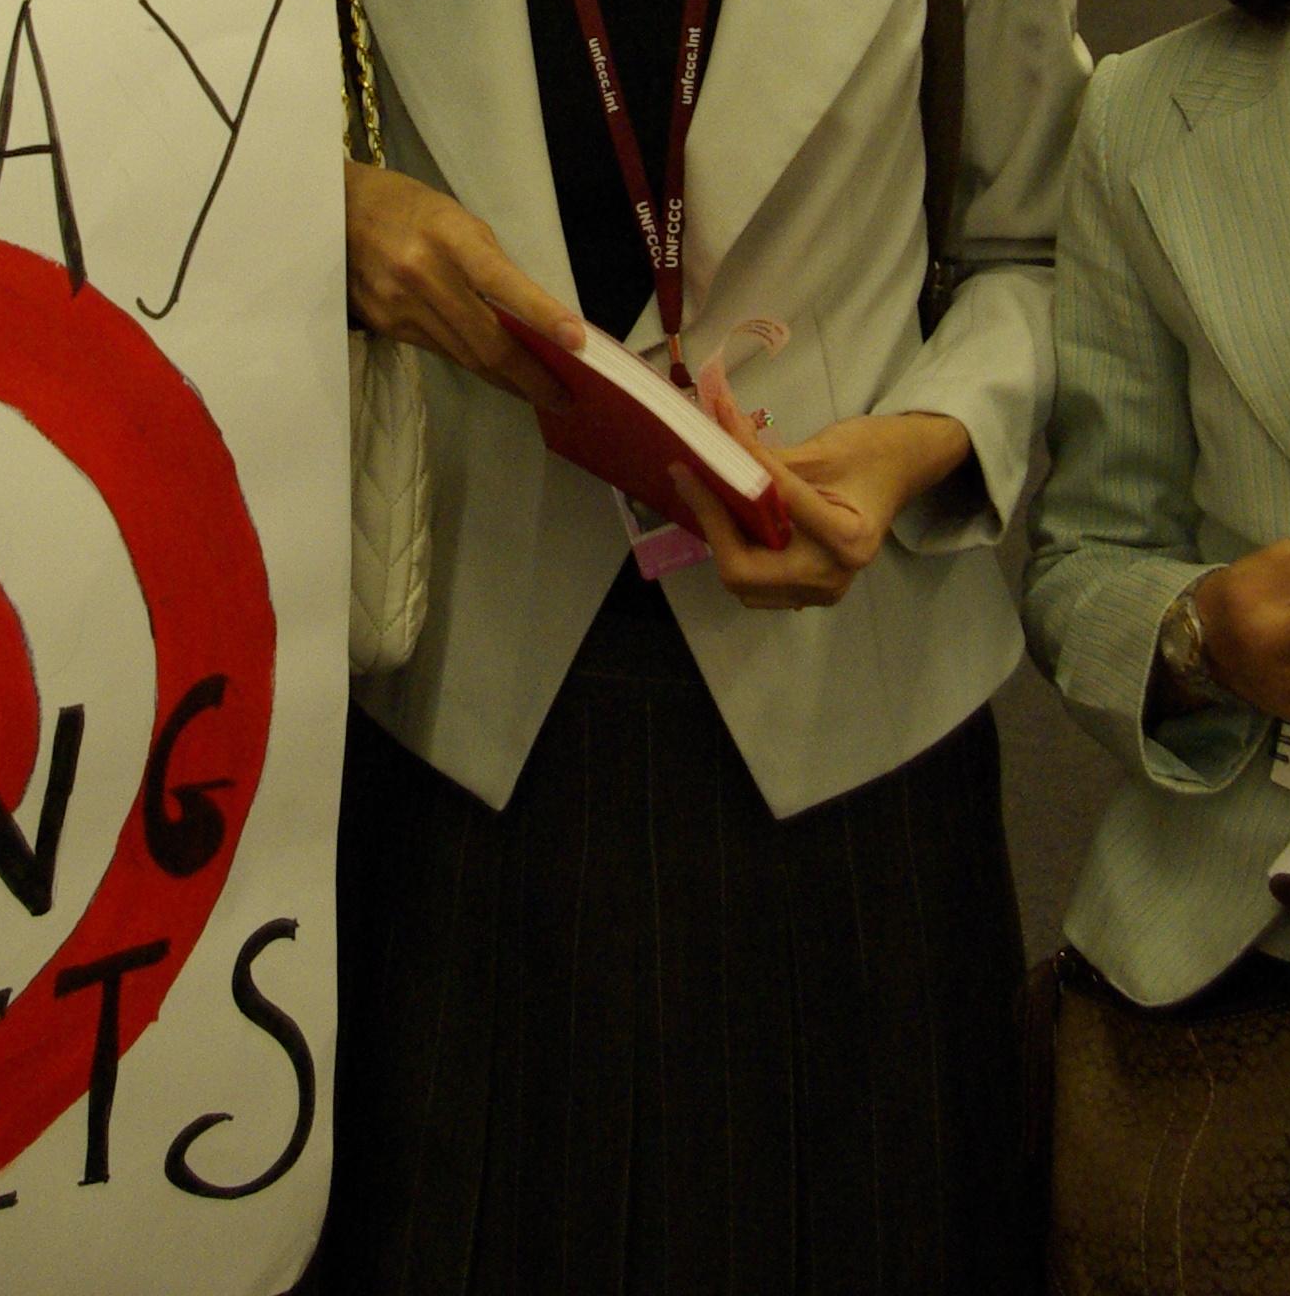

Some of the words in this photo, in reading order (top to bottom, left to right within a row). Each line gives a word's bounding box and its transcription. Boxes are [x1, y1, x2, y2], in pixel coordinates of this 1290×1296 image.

[588, 37, 620, 113] unfccc.int
[682, 27, 702, 105] unfccc.int
[665, 198, 683, 268] UNFCCC
